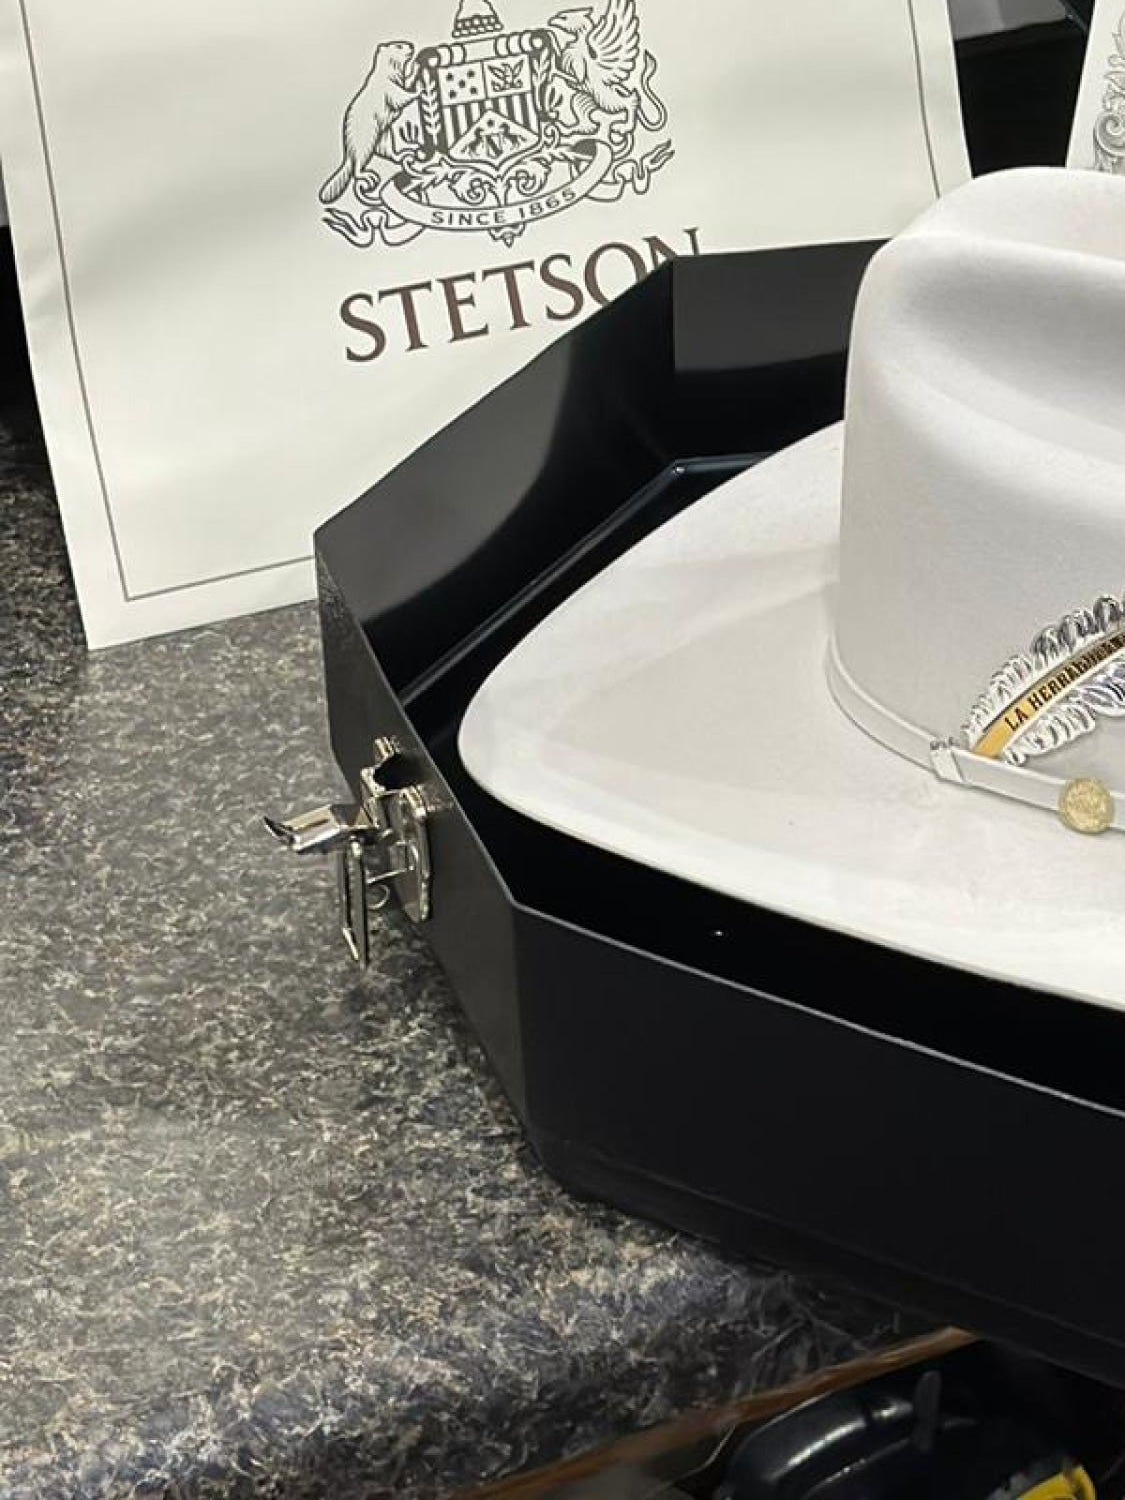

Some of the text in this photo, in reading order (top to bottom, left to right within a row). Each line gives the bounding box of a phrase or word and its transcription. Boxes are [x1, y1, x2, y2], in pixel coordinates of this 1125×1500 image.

[430, 189, 577, 227] SINCE 1865
[1004, 707, 1029, 732] LA
